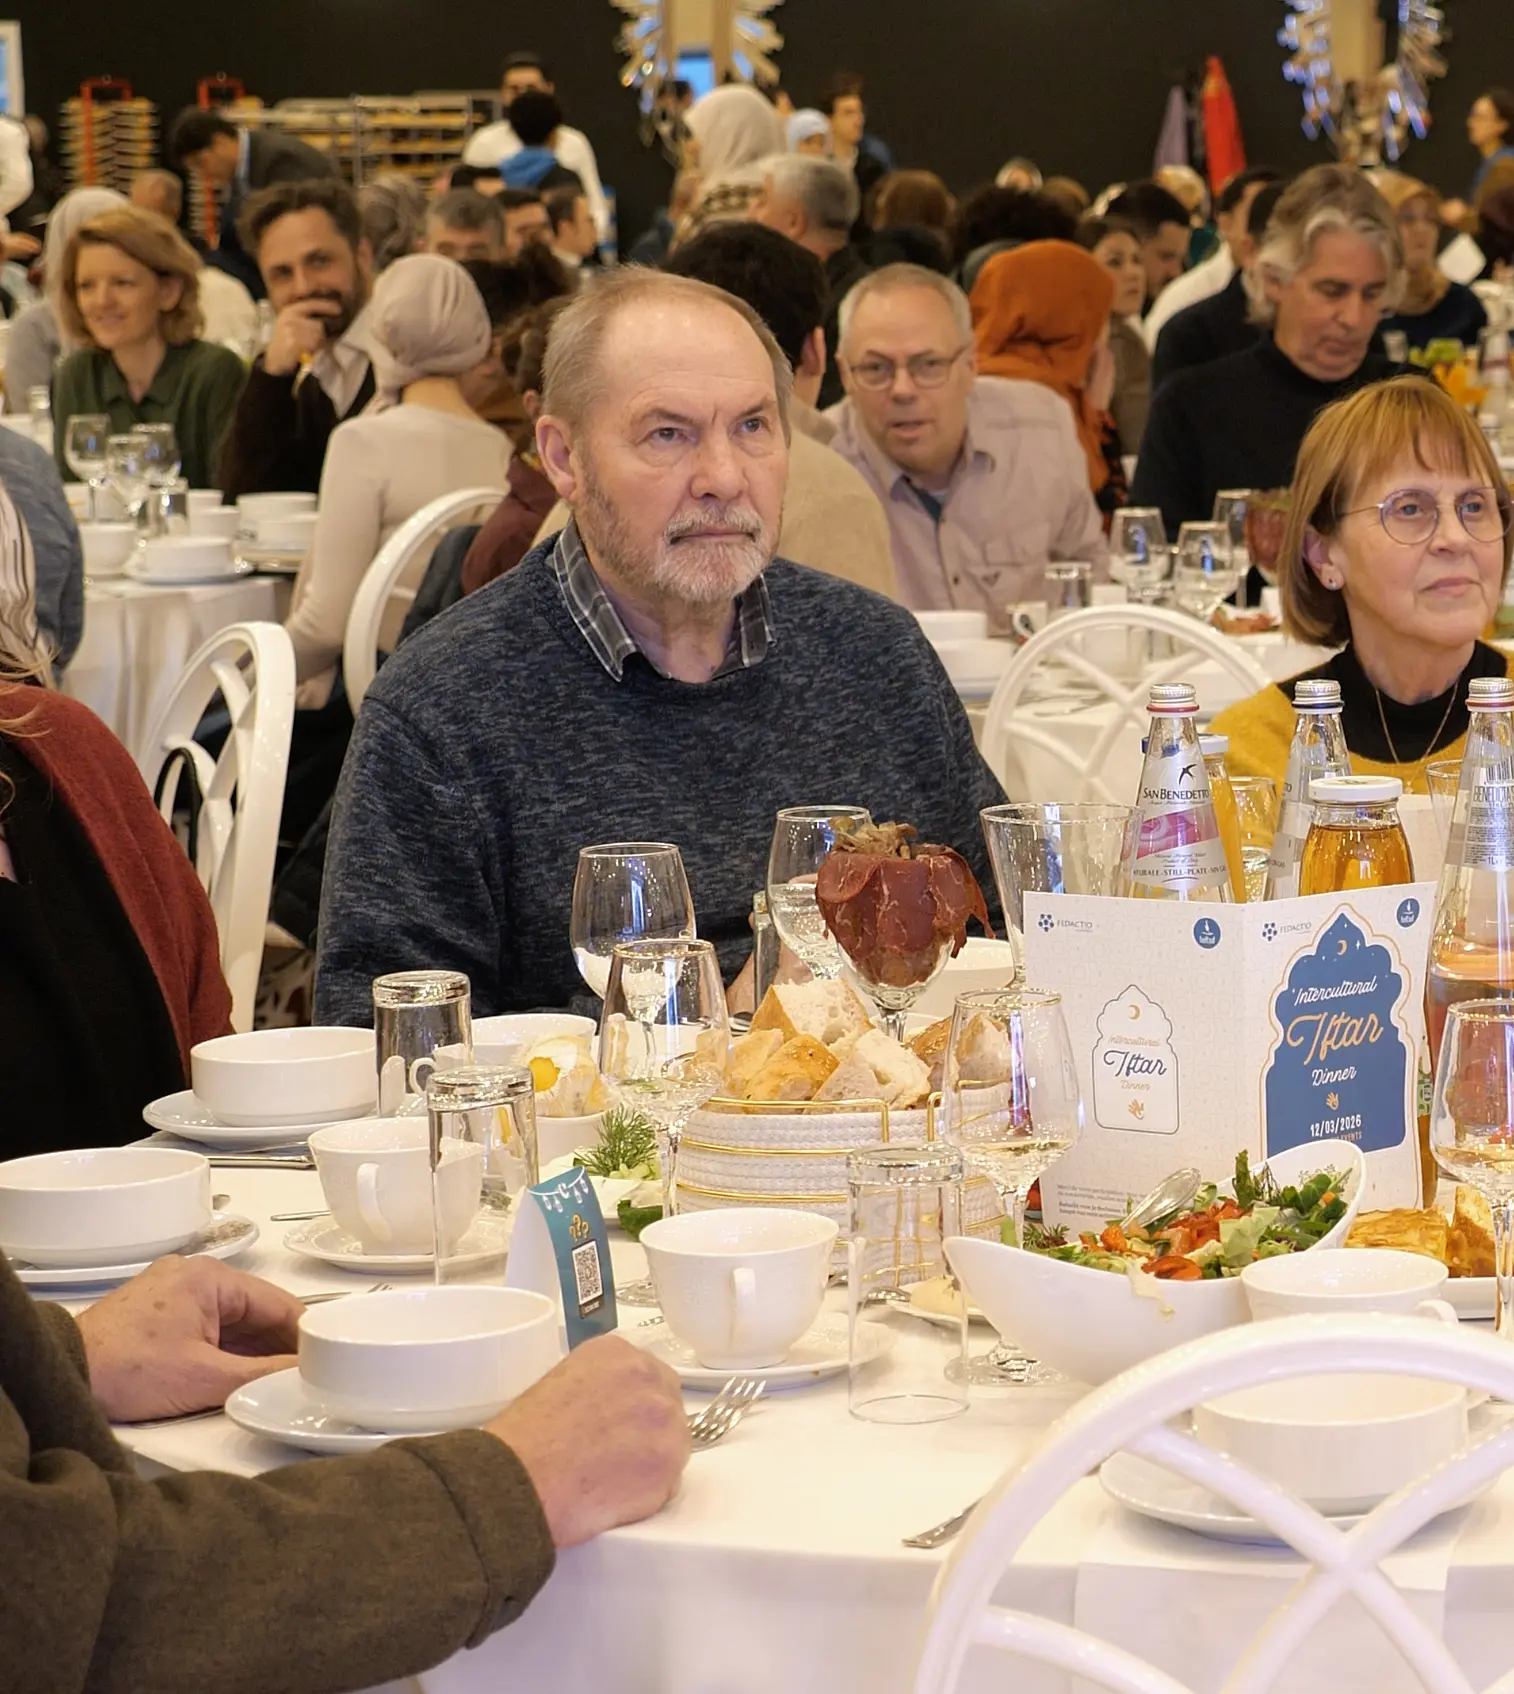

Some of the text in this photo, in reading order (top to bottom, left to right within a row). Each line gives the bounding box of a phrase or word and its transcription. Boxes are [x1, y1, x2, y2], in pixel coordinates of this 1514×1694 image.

[1293, 975, 1377, 1006] Intercultural
[1108, 1034, 1161, 1047] Intercultural
[1286, 1011, 1384, 1066] Iftar
[1103, 1050, 1168, 1077] Iftar
[1120, 1080, 1151, 1091] Dinner
[1311, 1066, 1357, 1086] Dinner
[1310, 1114, 1362, 1137] 12/03/2026
